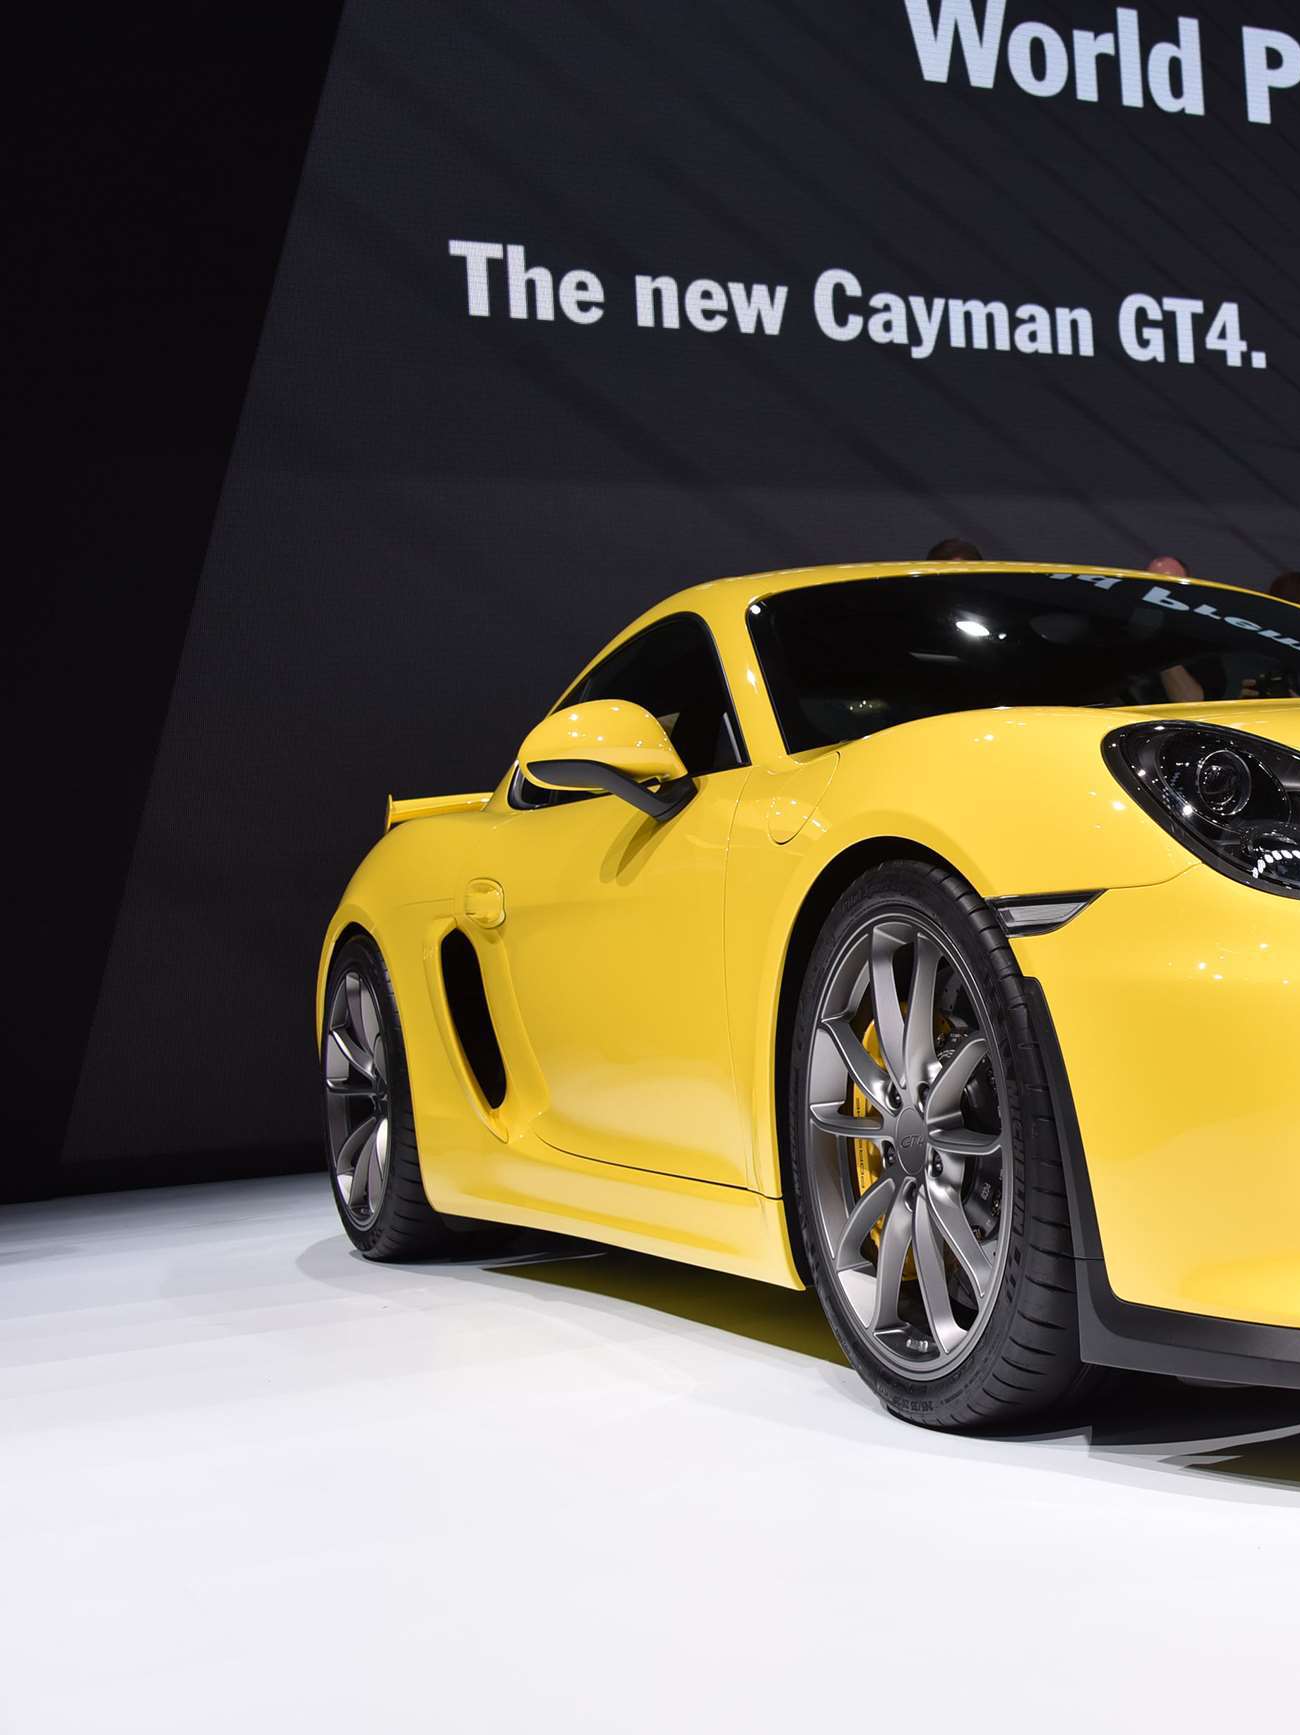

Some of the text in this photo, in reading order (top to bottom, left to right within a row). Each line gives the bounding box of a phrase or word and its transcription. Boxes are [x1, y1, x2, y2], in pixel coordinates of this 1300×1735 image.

[905, 0, 1204, 116] World
[448, 239, 1268, 370] The new Cayman GT4.
